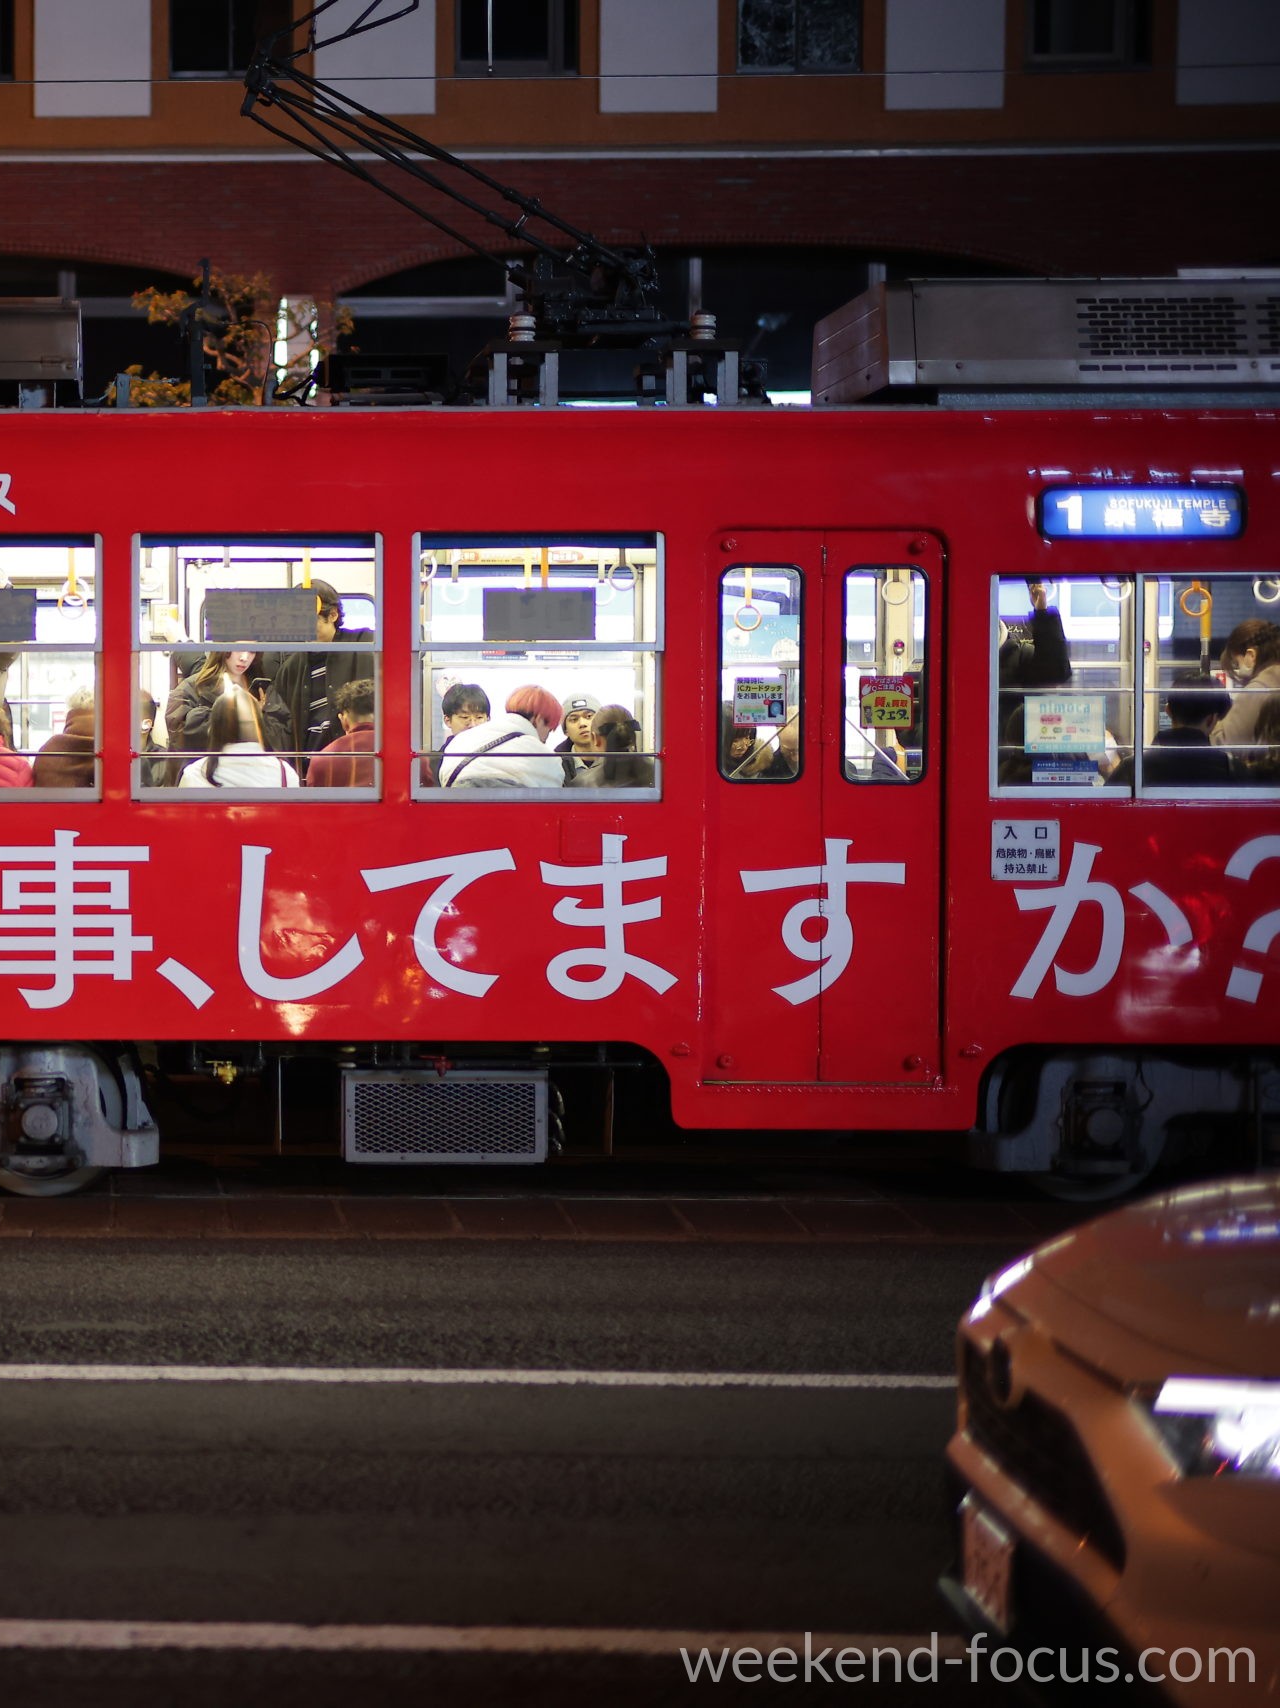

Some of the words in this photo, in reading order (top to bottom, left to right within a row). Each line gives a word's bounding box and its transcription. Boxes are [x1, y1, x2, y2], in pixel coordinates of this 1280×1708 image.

[1109, 498, 1172, 509] SOFUKUJI
[1177, 498, 1227, 509] TEMPLE
[1056, 495, 1083, 530] 1
[736, 692, 784, 700] をお願いします
[1039, 702, 1090, 714] nimoca
[1004, 826, 1048, 839] 入口
[995, 847, 1056, 860] 危険物・鳥獣
[1004, 863, 1048, 875] 持込禁止
